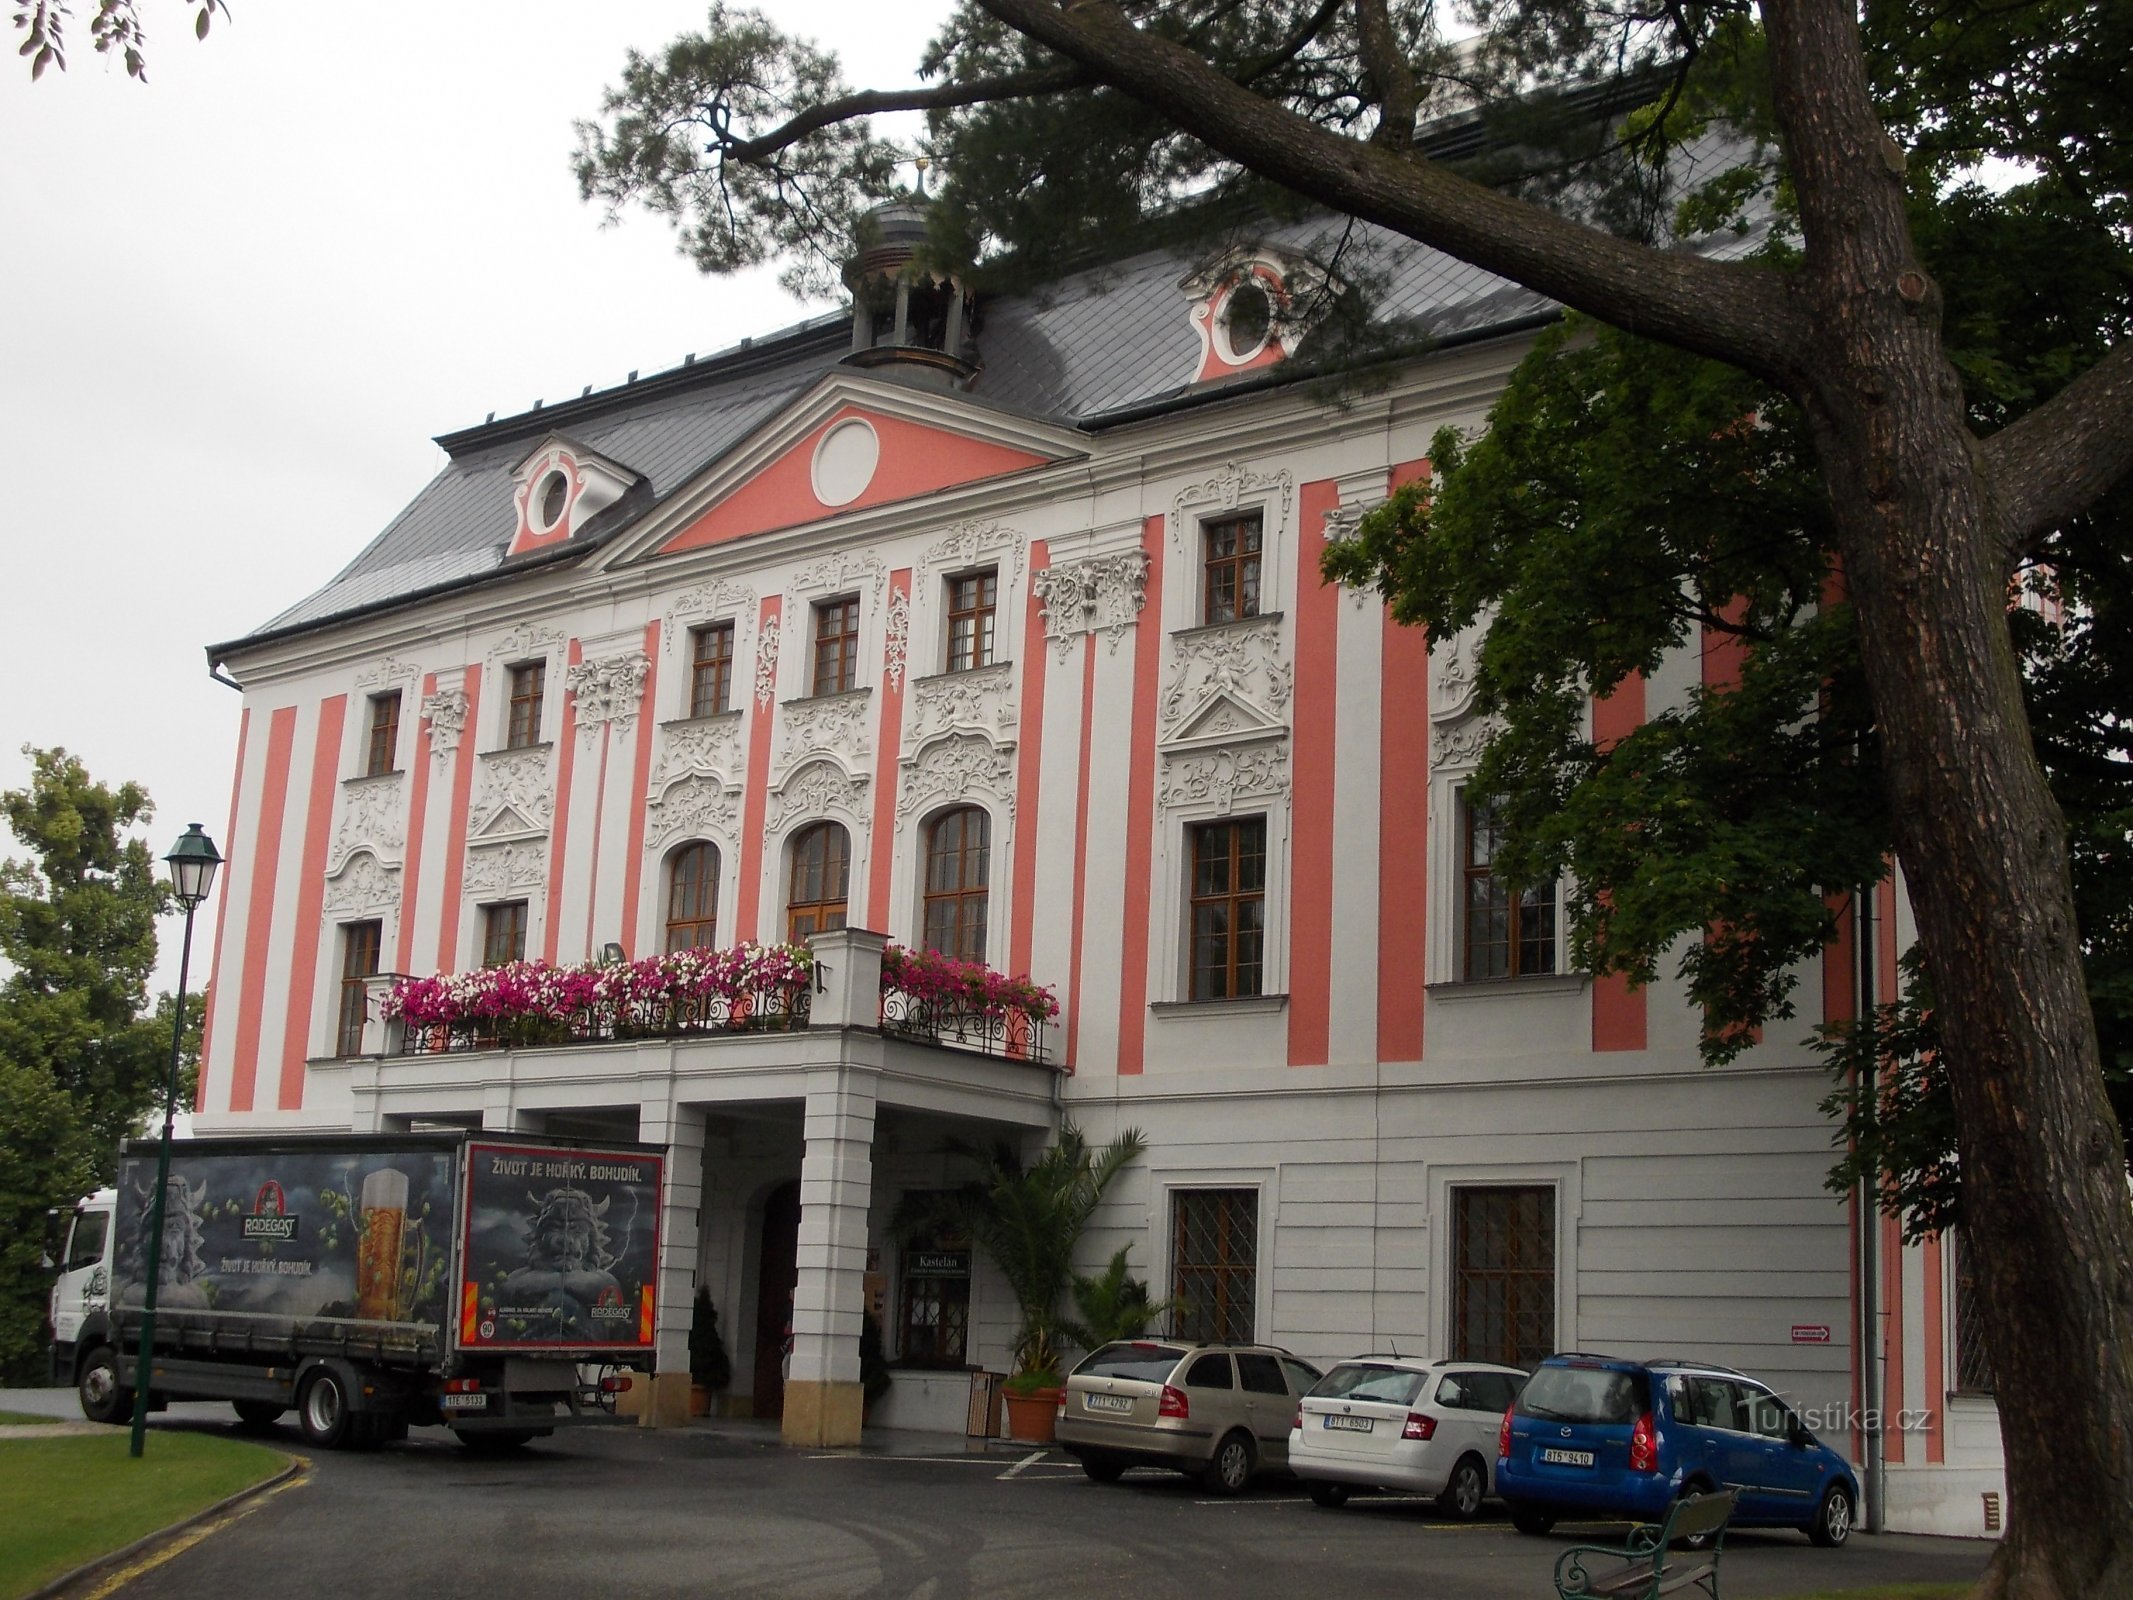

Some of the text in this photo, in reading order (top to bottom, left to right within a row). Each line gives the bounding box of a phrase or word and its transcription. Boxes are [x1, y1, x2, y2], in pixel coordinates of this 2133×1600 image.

[492, 1157, 642, 1182] ŽIVOT JE HOŘKÝ. BOHUDÍK.
[245, 1219, 296, 1238] RADEGAST
[242, 1259, 250, 1273] JE
[591, 1307, 631, 1319] RADEGAST
[483, 1323, 492, 1334] 90
[1546, 1450, 1589, 1464] 8T5 9410
